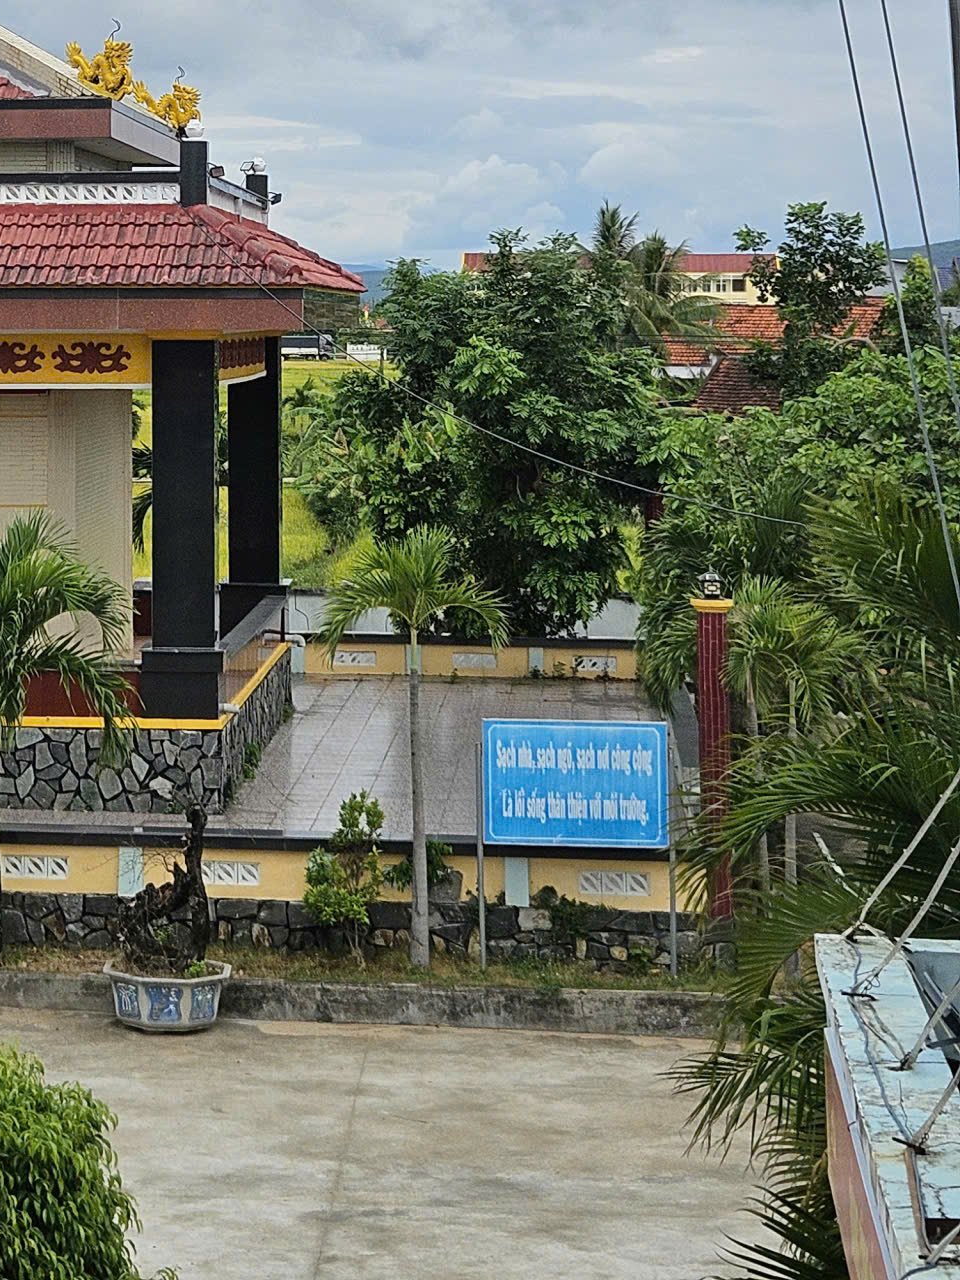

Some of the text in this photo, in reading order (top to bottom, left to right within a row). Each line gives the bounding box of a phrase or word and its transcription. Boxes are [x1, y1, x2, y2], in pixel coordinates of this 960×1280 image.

[496, 739, 516, 774] Sạch
[536, 740, 556, 775] sạch
[576, 741, 596, 776] sạch
[596, 742, 610, 769] nơi
[611, 743, 632, 776] công
[632, 743, 653, 777] cộng
[502, 788, 513, 817] Là
[526, 787, 547, 824] sống
[547, 791, 567, 818] thân
[567, 791, 589, 825] thiện
[589, 792, 602, 819] với
[603, 792, 618, 820] môi
